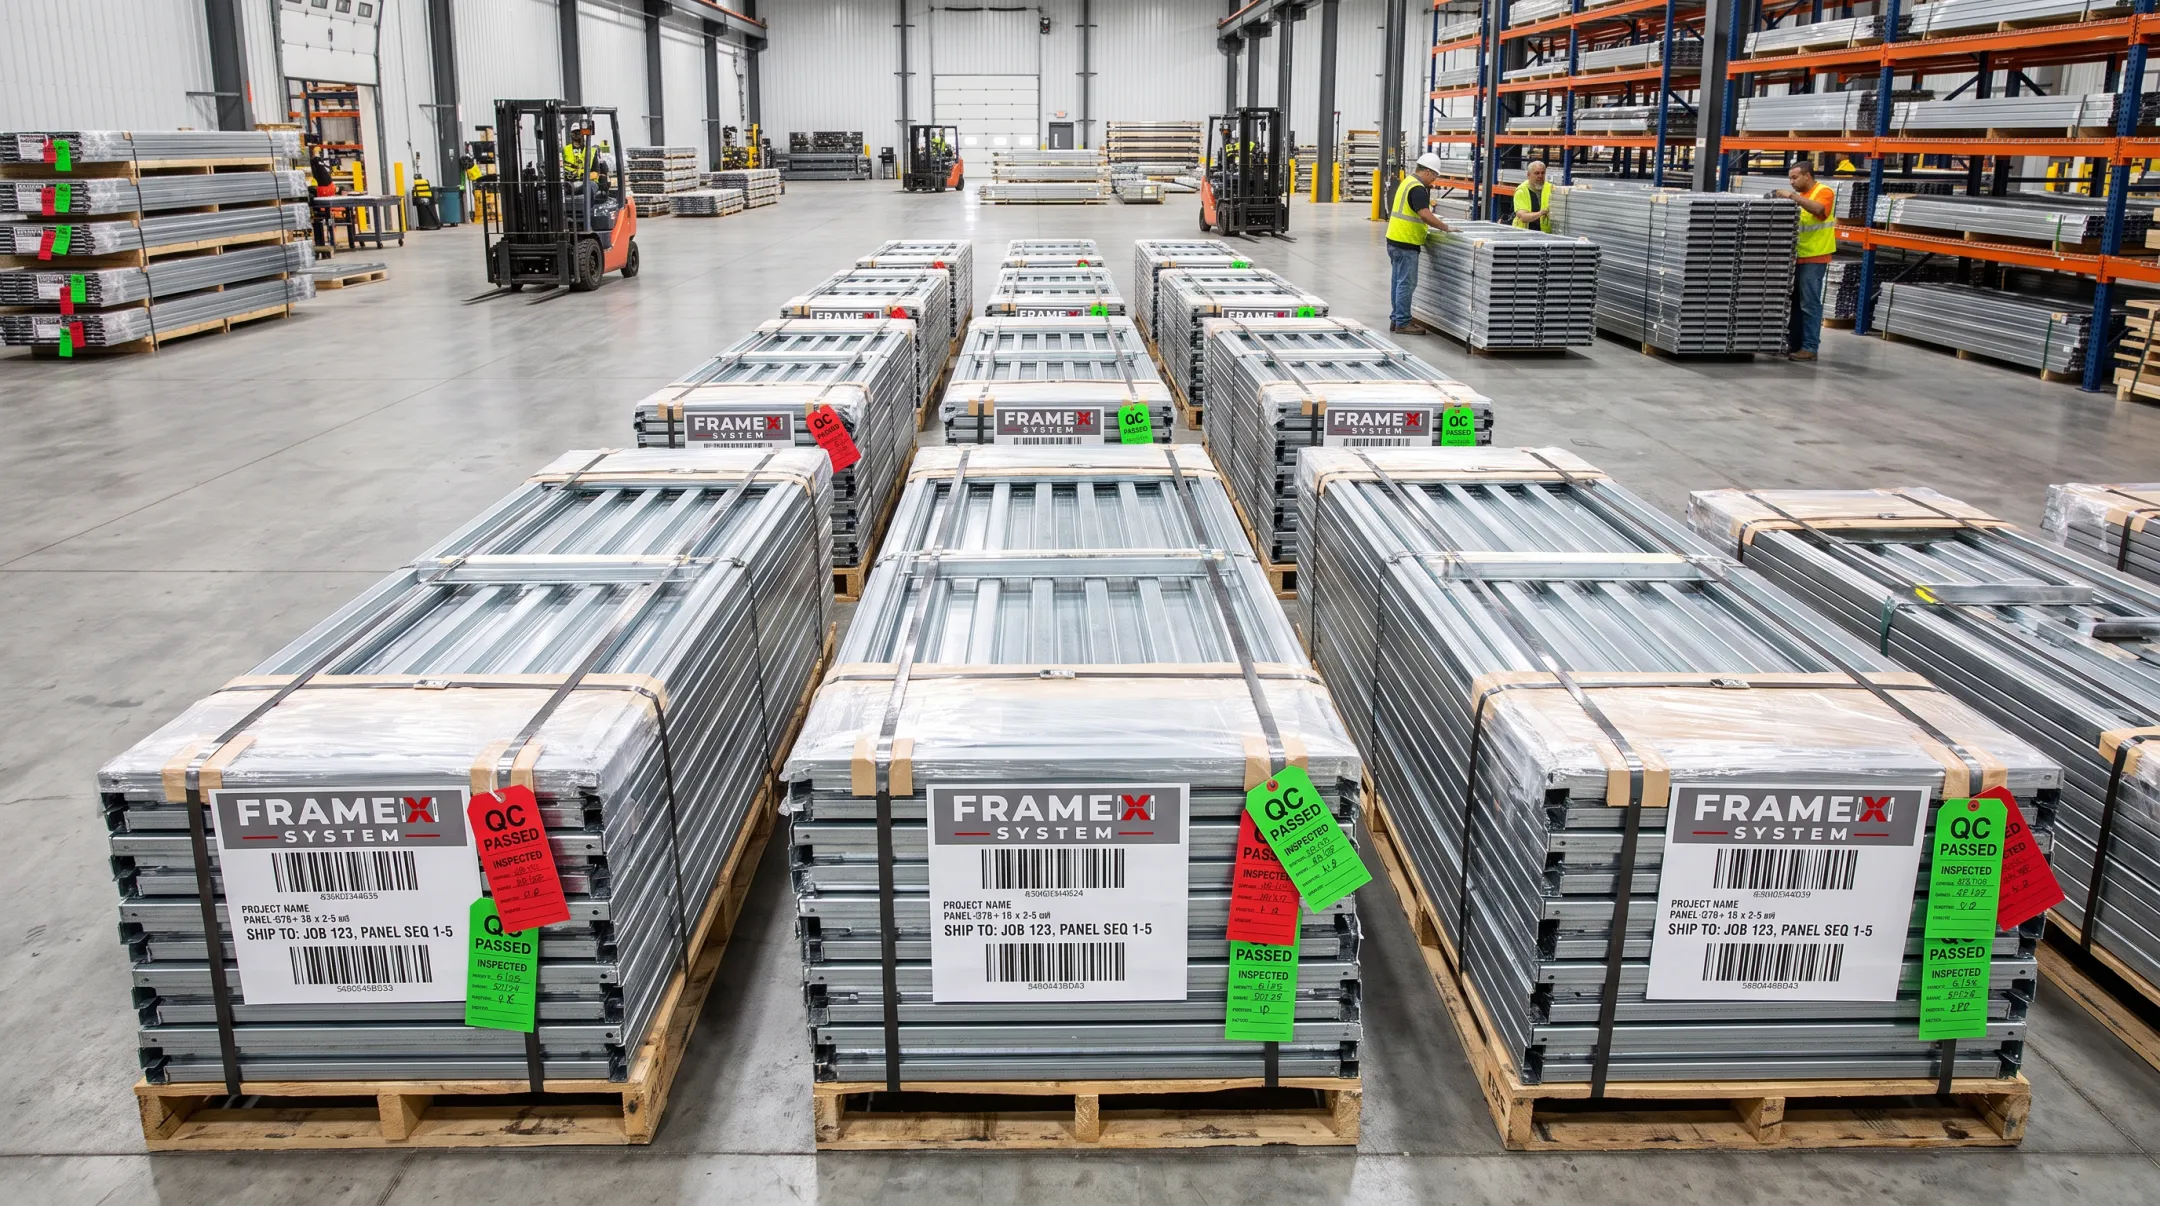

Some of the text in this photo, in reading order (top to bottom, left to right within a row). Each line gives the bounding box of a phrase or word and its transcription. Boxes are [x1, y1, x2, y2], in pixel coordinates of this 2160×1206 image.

[1125, 412, 1144, 425] QC
[712, 432, 764, 440] SYSTEM
[1022, 426, 1075, 434] SYSTEM
[1351, 427, 1403, 435] SYSTEM
[236, 796, 440, 827] FRAMEX
[953, 794, 1156, 823] FRAMEX
[1264, 787, 1304, 821] QC
[1694, 794, 1896, 823] FRAMEX
[484, 804, 526, 832] QC
[1270, 803, 1322, 842] PASSED
[996, 826, 1113, 841] SYSTEM
[1734, 826, 1848, 841] SYSTEM
[1950, 817, 1991, 840] QC
[284, 829, 400, 844] SYSTEM
[483, 827, 540, 852] PASSED
[1283, 823, 1329, 857] INSPECTED
[1243, 846, 1280, 862] PASS
[1940, 843, 1997, 857] PASSED
[492, 850, 543, 869] INSPECTED
[1243, 869, 1291, 881] INSPECTE
[1941, 865, 1992, 876] INSPECTED
[241, 904, 310, 914] PROJECT NAME
[943, 900, 1012, 910] PROJECT NAME
[1671, 900, 1739, 909] PROJECT NAME
[322, 914, 336, 923] 2-5
[1022, 911, 1037, 920] 2-5
[1748, 911, 1762, 920] 2-5
[246, 925, 453, 941] SHIP TO: JOB 123, PANEL SEQ 1-5
[484, 915, 523, 938] Q
[944, 923, 1153, 937] SHIP TO: JOB 123, PANEL SEQ 1-5
[1668, 923, 1873, 938] SHIP TO: JOB 123, PANEL SEQ 1-5
[475, 938, 532, 955] PASSED
[1930, 946, 1986, 961] PASSED
[1236, 948, 1293, 962] PASSED
[477, 959, 528, 972] INSPECTED
[1238, 970, 1289, 981] INSPECTED
[1931, 968, 1981, 979] INSPECTED
